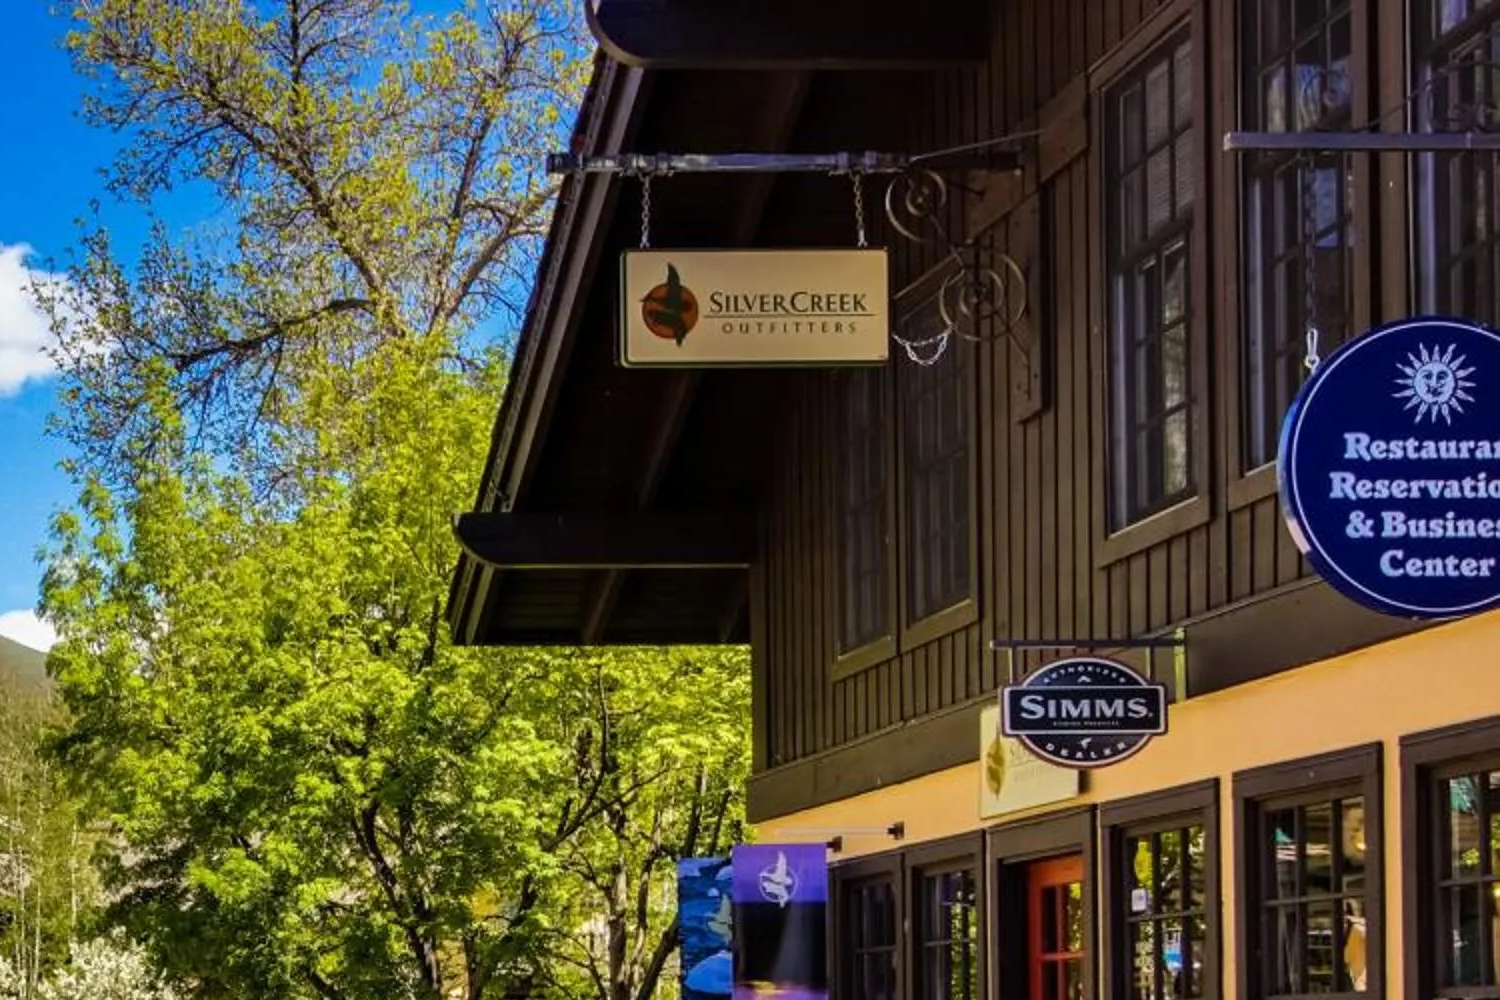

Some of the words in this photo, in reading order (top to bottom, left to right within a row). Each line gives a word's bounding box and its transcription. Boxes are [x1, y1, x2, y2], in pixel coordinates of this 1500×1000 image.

[721, 321, 858, 335] OUTFITTERS
[1345, 510, 1375, 538] &
[1380, 510, 1500, 538] Busine
[1379, 549, 1496, 577] Center
[1019, 694, 1149, 720] SIMMS
[1045, 742, 1127, 760] DEALER
